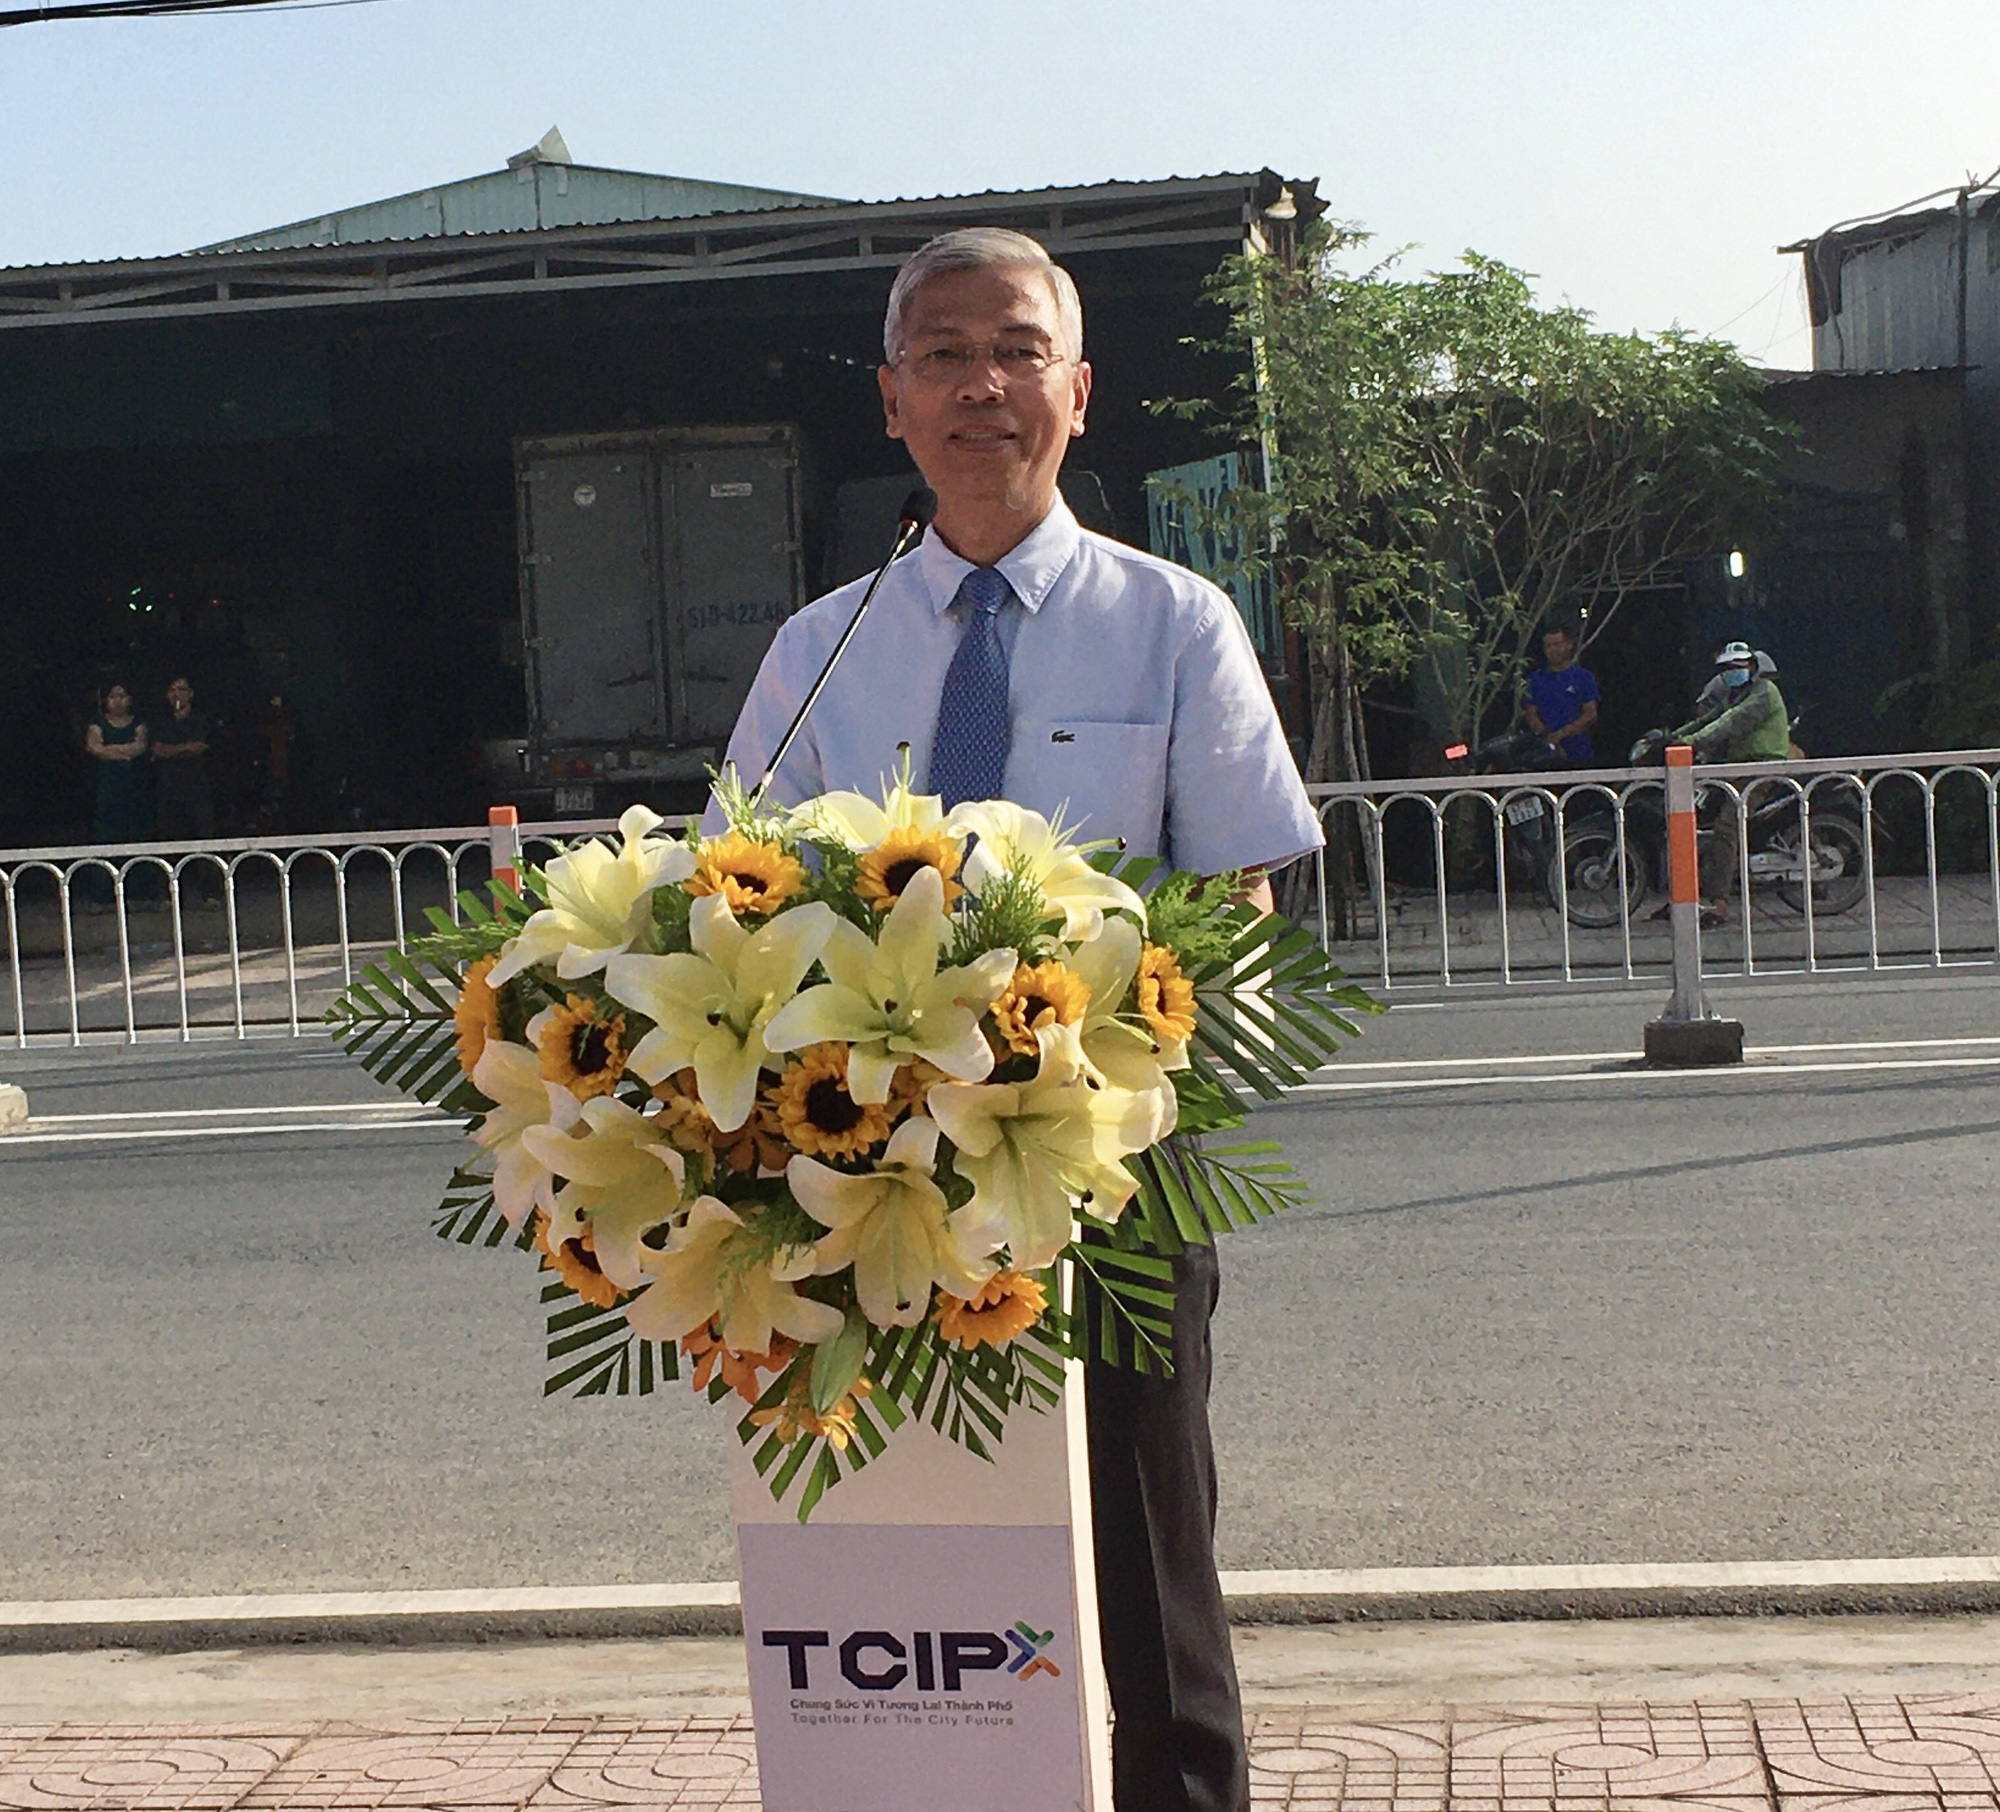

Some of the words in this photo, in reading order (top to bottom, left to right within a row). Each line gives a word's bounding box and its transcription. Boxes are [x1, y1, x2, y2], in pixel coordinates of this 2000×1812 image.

[762, 1630, 1008, 1691] TCIP
[790, 1698, 832, 1711] Chung
[791, 1712, 856, 1725] Together
[864, 1714, 887, 1724] For
[896, 1714, 922, 1725] The
[928, 1714, 957, 1727] City
[966, 1715, 1014, 1726] Future
